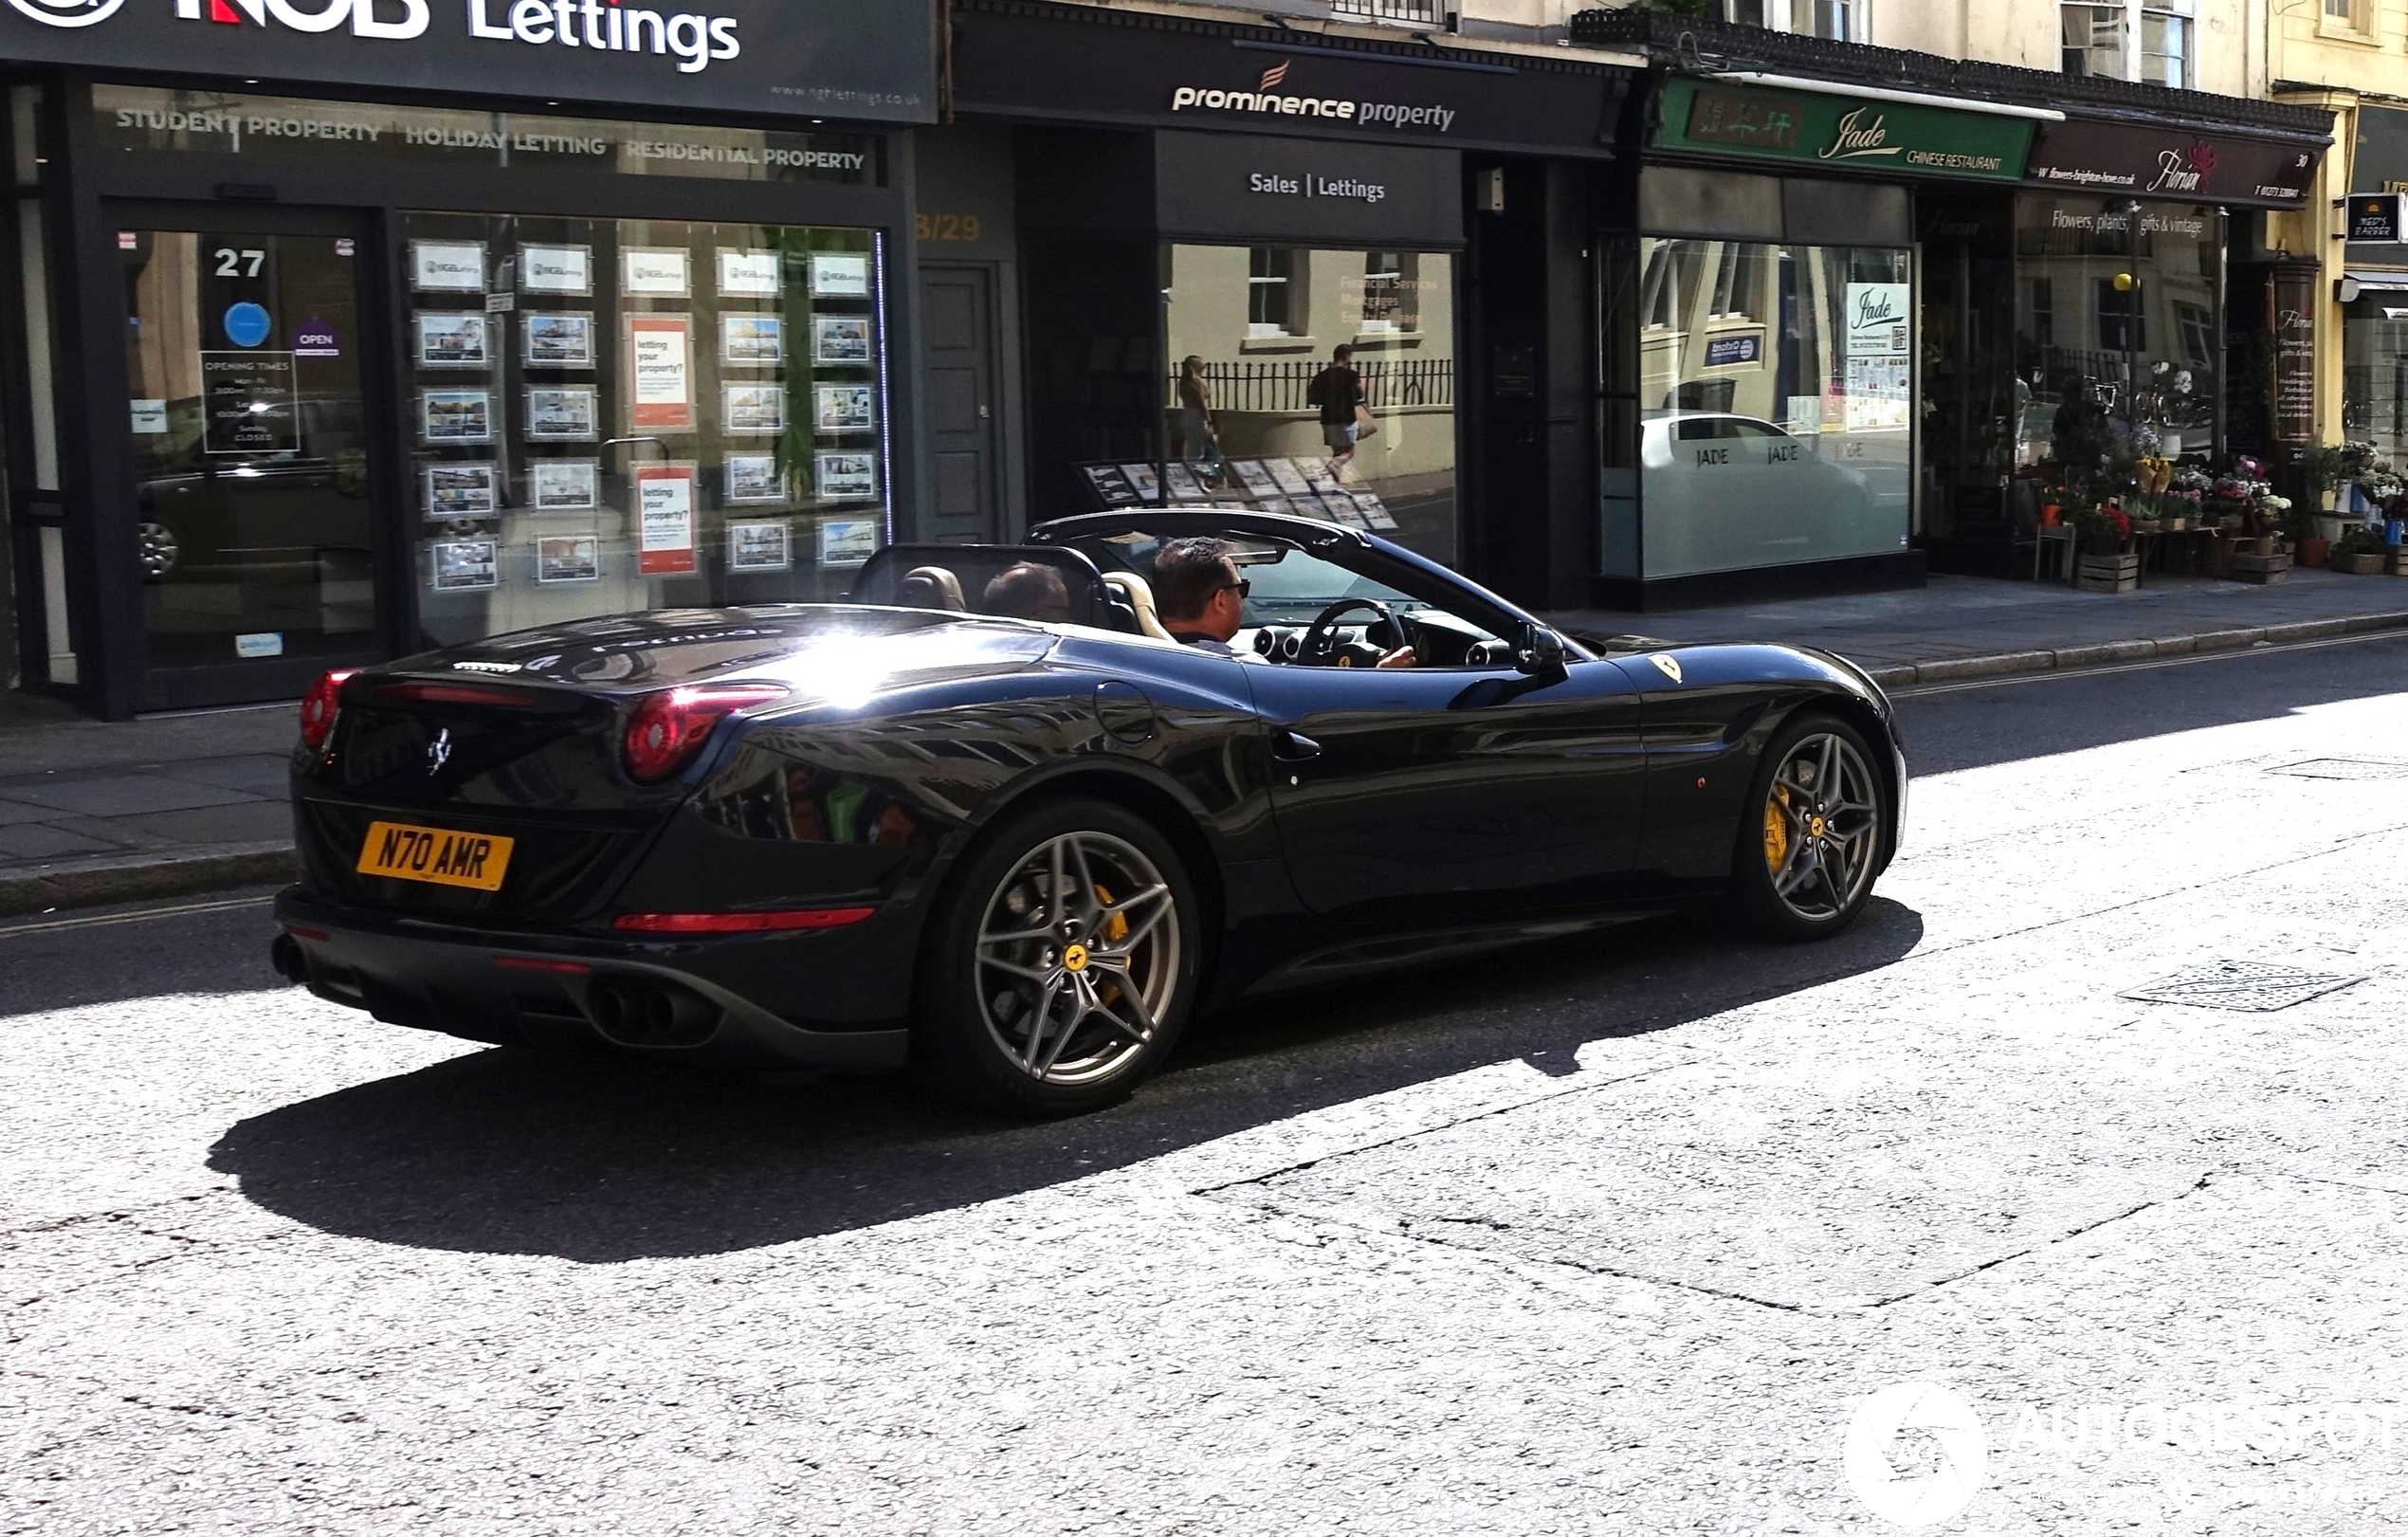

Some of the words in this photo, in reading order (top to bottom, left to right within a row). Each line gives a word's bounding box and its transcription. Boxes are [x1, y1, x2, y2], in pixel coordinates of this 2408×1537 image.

[466, 0, 740, 73] Lettings
[1172, 86, 1356, 119] prominence
[1358, 101, 1455, 132] property
[116, 108, 241, 135] STUDENT
[247, 116, 379, 141] PROPERTY
[1818, 106, 1887, 159] Jade
[406, 126, 507, 150] HOLIDAY
[513, 134, 607, 156] LETTING
[626, 140, 758, 164] RESIDENTIAL
[764, 148, 864, 170] PROPERTY
[1906, 151, 1944, 167] CHINESE
[1945, 154, 2002, 171] RESTAURANT
[2296, 155, 2308, 167] 30
[2146, 149, 2200, 192] Florian
[1250, 173, 1299, 194] Sales
[1318, 176, 1384, 203] Lettings
[2052, 210, 2094, 230] Flowers,
[2096, 211, 2129, 235] plants,
[2140, 214, 2160, 235] gifts
[2161, 216, 2169, 231] &
[2170, 216, 2203, 238] vintage
[2355, 227, 2391, 236] BARBER
[214, 248, 265, 277] 27
[1851, 286, 1891, 330] Jade
[300, 335, 333, 344] OPEN
[638, 340, 667, 351] letting
[205, 362, 254, 371] OPENING
[256, 362, 289, 371] TIMES
[638, 354, 659, 363] your
[638, 363, 684, 374] property?
[1696, 448, 1729, 468] JADE
[1768, 445, 1798, 465] JADE
[1834, 442, 1864, 461] JDE
[643, 488, 673, 499] letting
[644, 501, 664, 510] your
[644, 510, 688, 521] property?
[377, 829, 433, 871] N70
[432, 835, 491, 879] AMR
